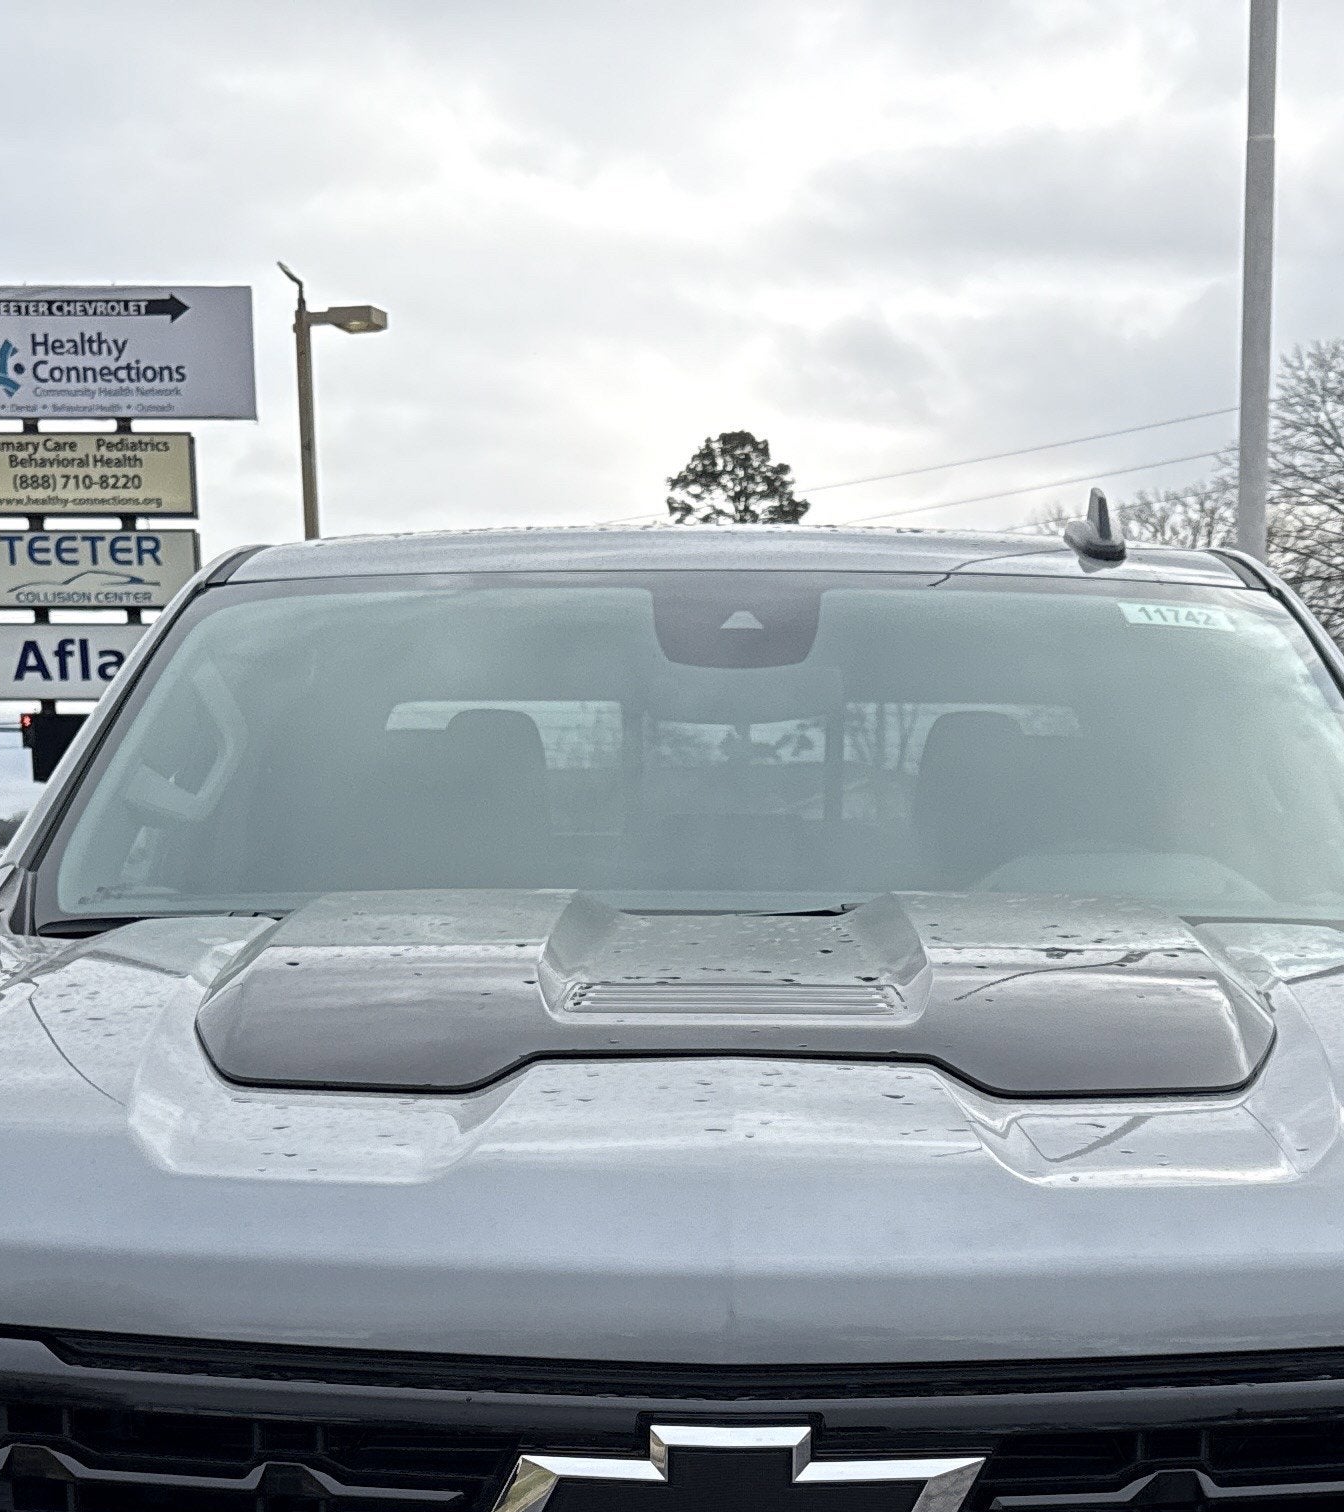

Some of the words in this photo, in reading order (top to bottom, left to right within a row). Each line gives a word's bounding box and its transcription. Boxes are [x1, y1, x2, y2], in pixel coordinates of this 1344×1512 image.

[51, 302, 149, 316] CHEVROLET
[30, 331, 128, 361] Healthy
[32, 359, 187, 384] Connections
[32, 386, 96, 399] Community
[97, 386, 134, 397] Health
[136, 387, 182, 397] Network
[42, 438, 78, 452] Care
[95, 438, 170, 452] Pediatrics
[8, 454, 90, 469] Behavioral
[92, 454, 144, 469] Health
[12, 474, 57, 492] (888)
[60, 474, 143, 491] 710-8220
[0, 535, 163, 567] TEETER
[15, 591, 93, 604] COLLISION
[94, 591, 152, 604] CENTER
[1138, 606, 1214, 626] 11742
